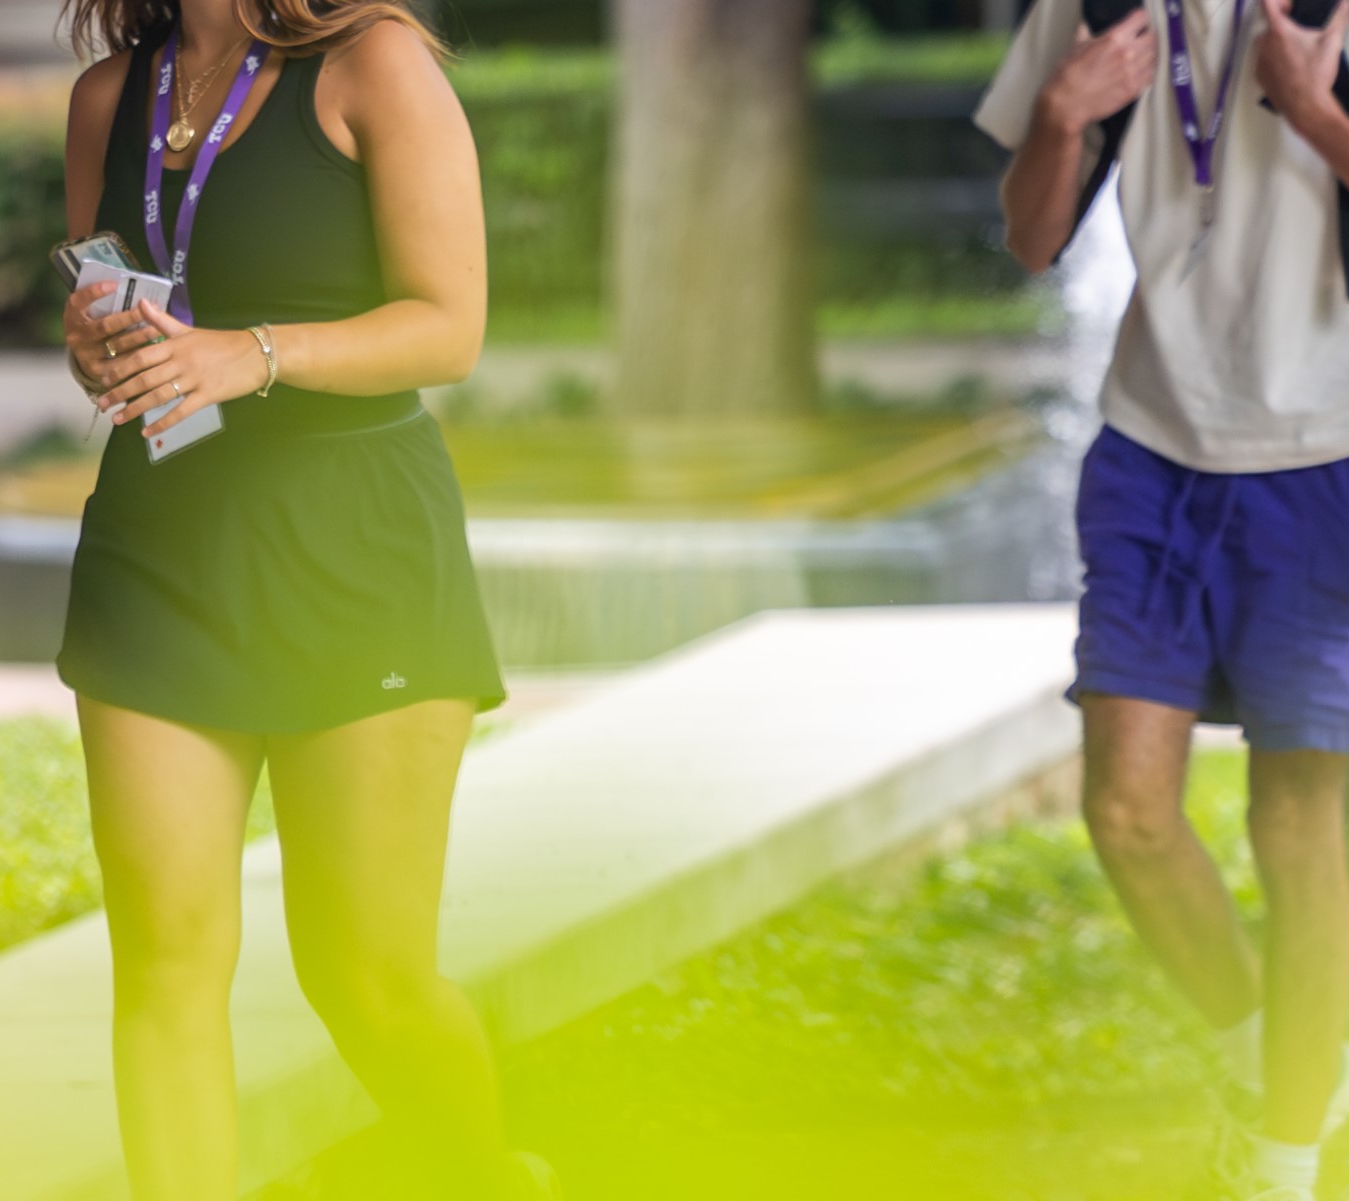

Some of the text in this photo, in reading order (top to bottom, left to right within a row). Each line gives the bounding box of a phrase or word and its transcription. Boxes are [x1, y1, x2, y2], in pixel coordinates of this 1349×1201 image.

[158, 62, 172, 96] TCU
[208, 113, 234, 144] TCU
[144, 190, 159, 224] TCU
[171, 249, 186, 286] TCU
[381, 671, 408, 689] alo
